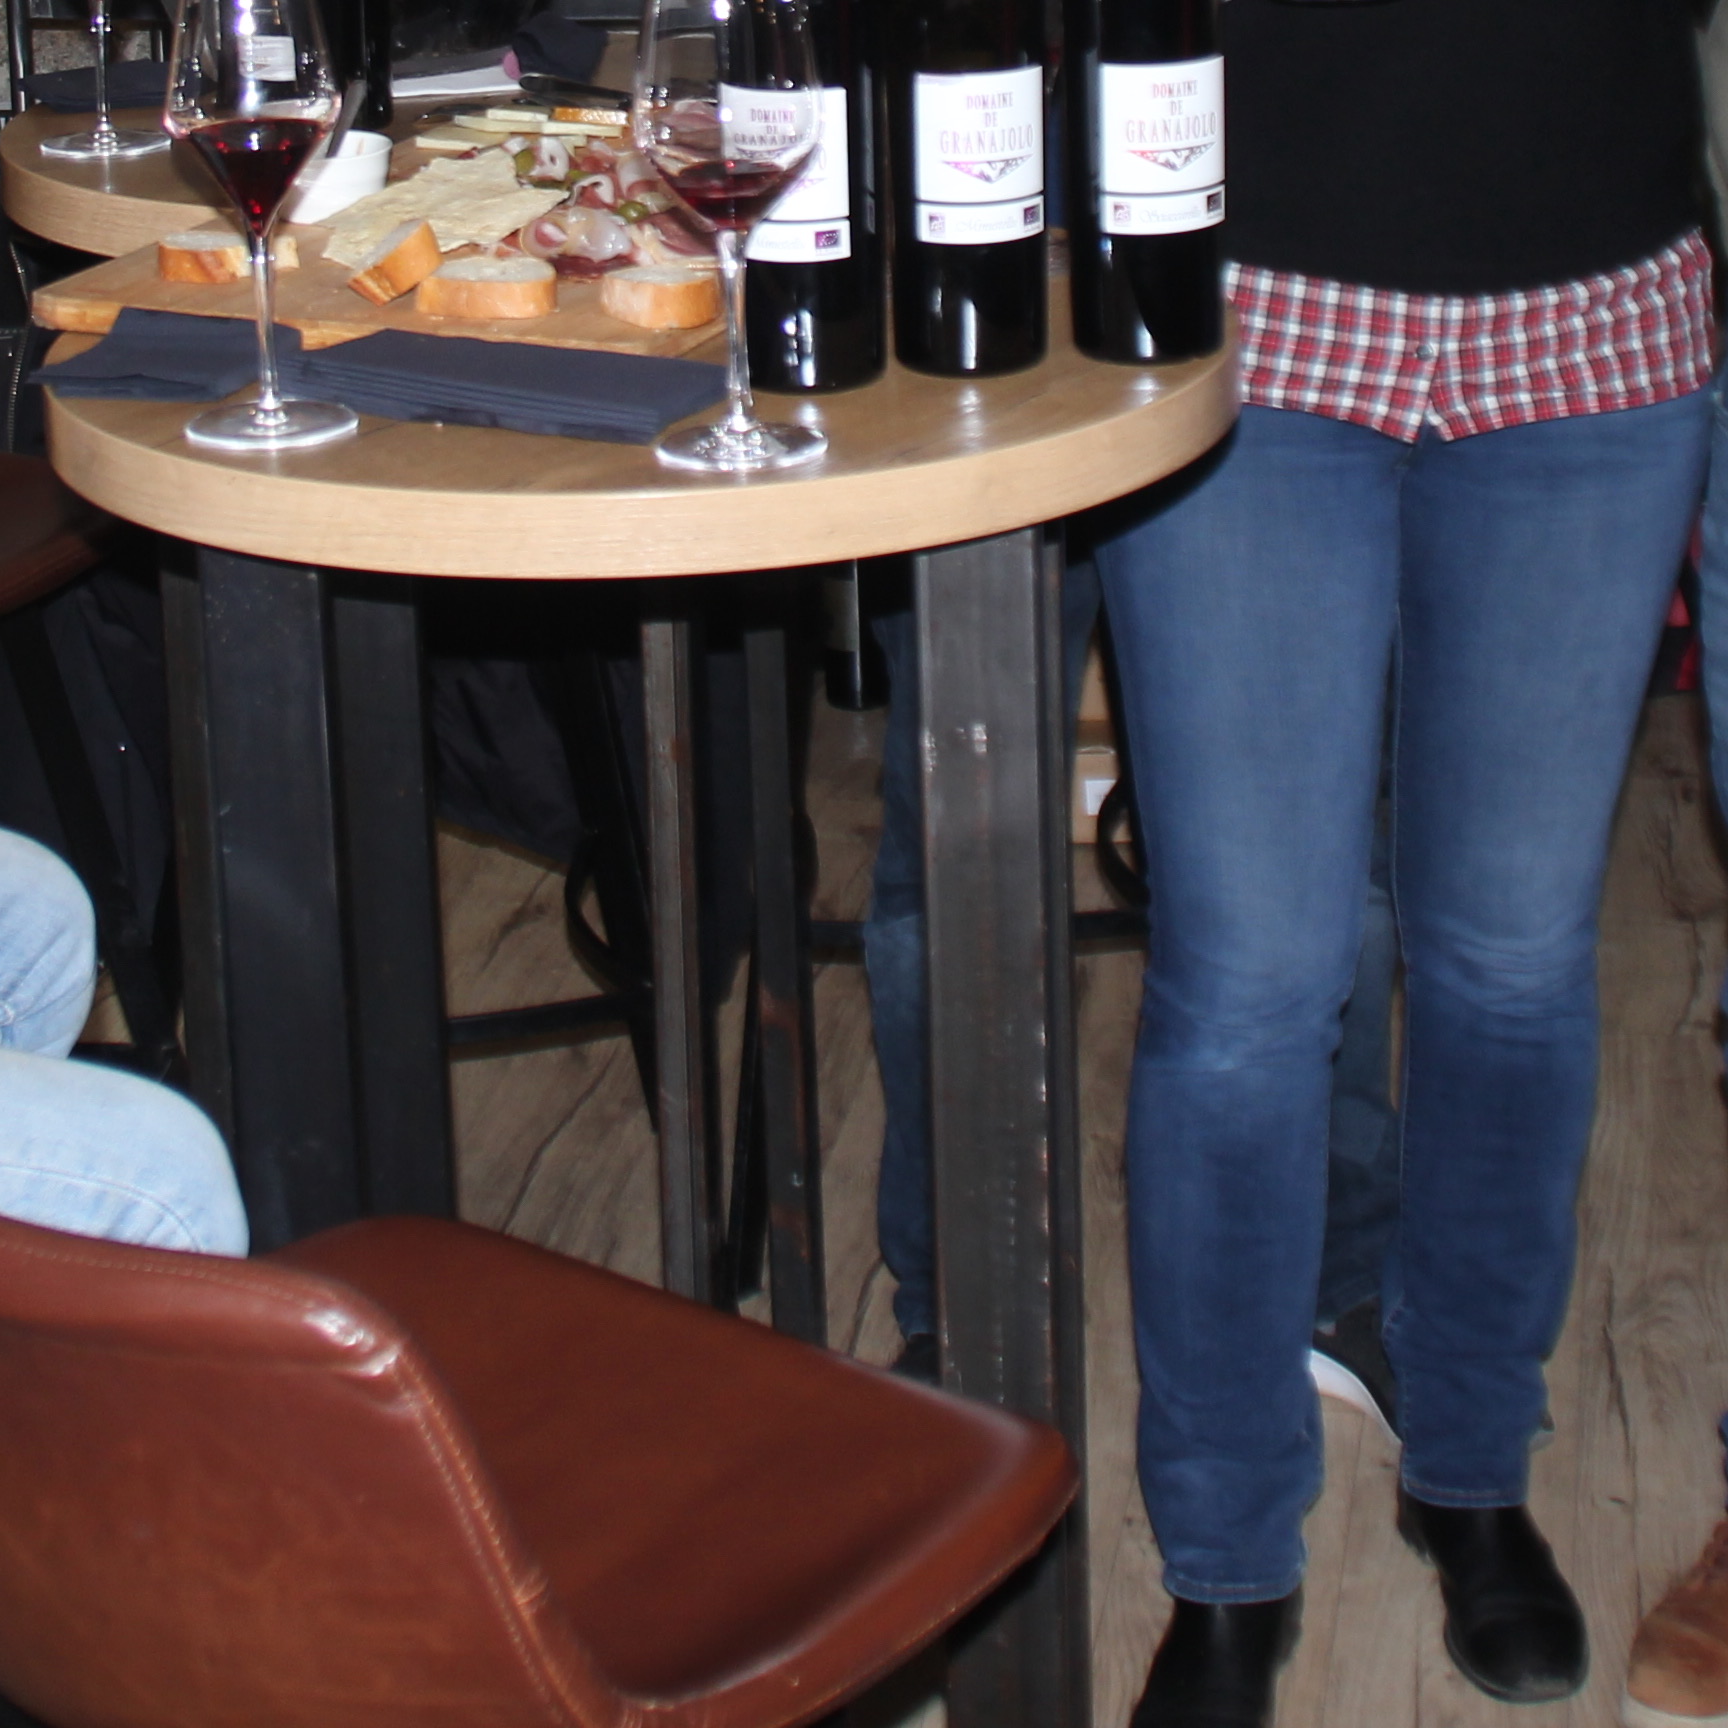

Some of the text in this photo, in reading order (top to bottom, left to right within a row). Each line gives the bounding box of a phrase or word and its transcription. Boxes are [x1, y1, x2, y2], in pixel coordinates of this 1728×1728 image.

[1151, 79, 1199, 99] DOMAINE
[966, 91, 1014, 110] DOMAINE
[1169, 100, 1184, 115] DE
[983, 112, 999, 128] DE
[1125, 111, 1218, 144] GRANAJOLO
[939, 124, 1035, 155] GRANAJOLO
